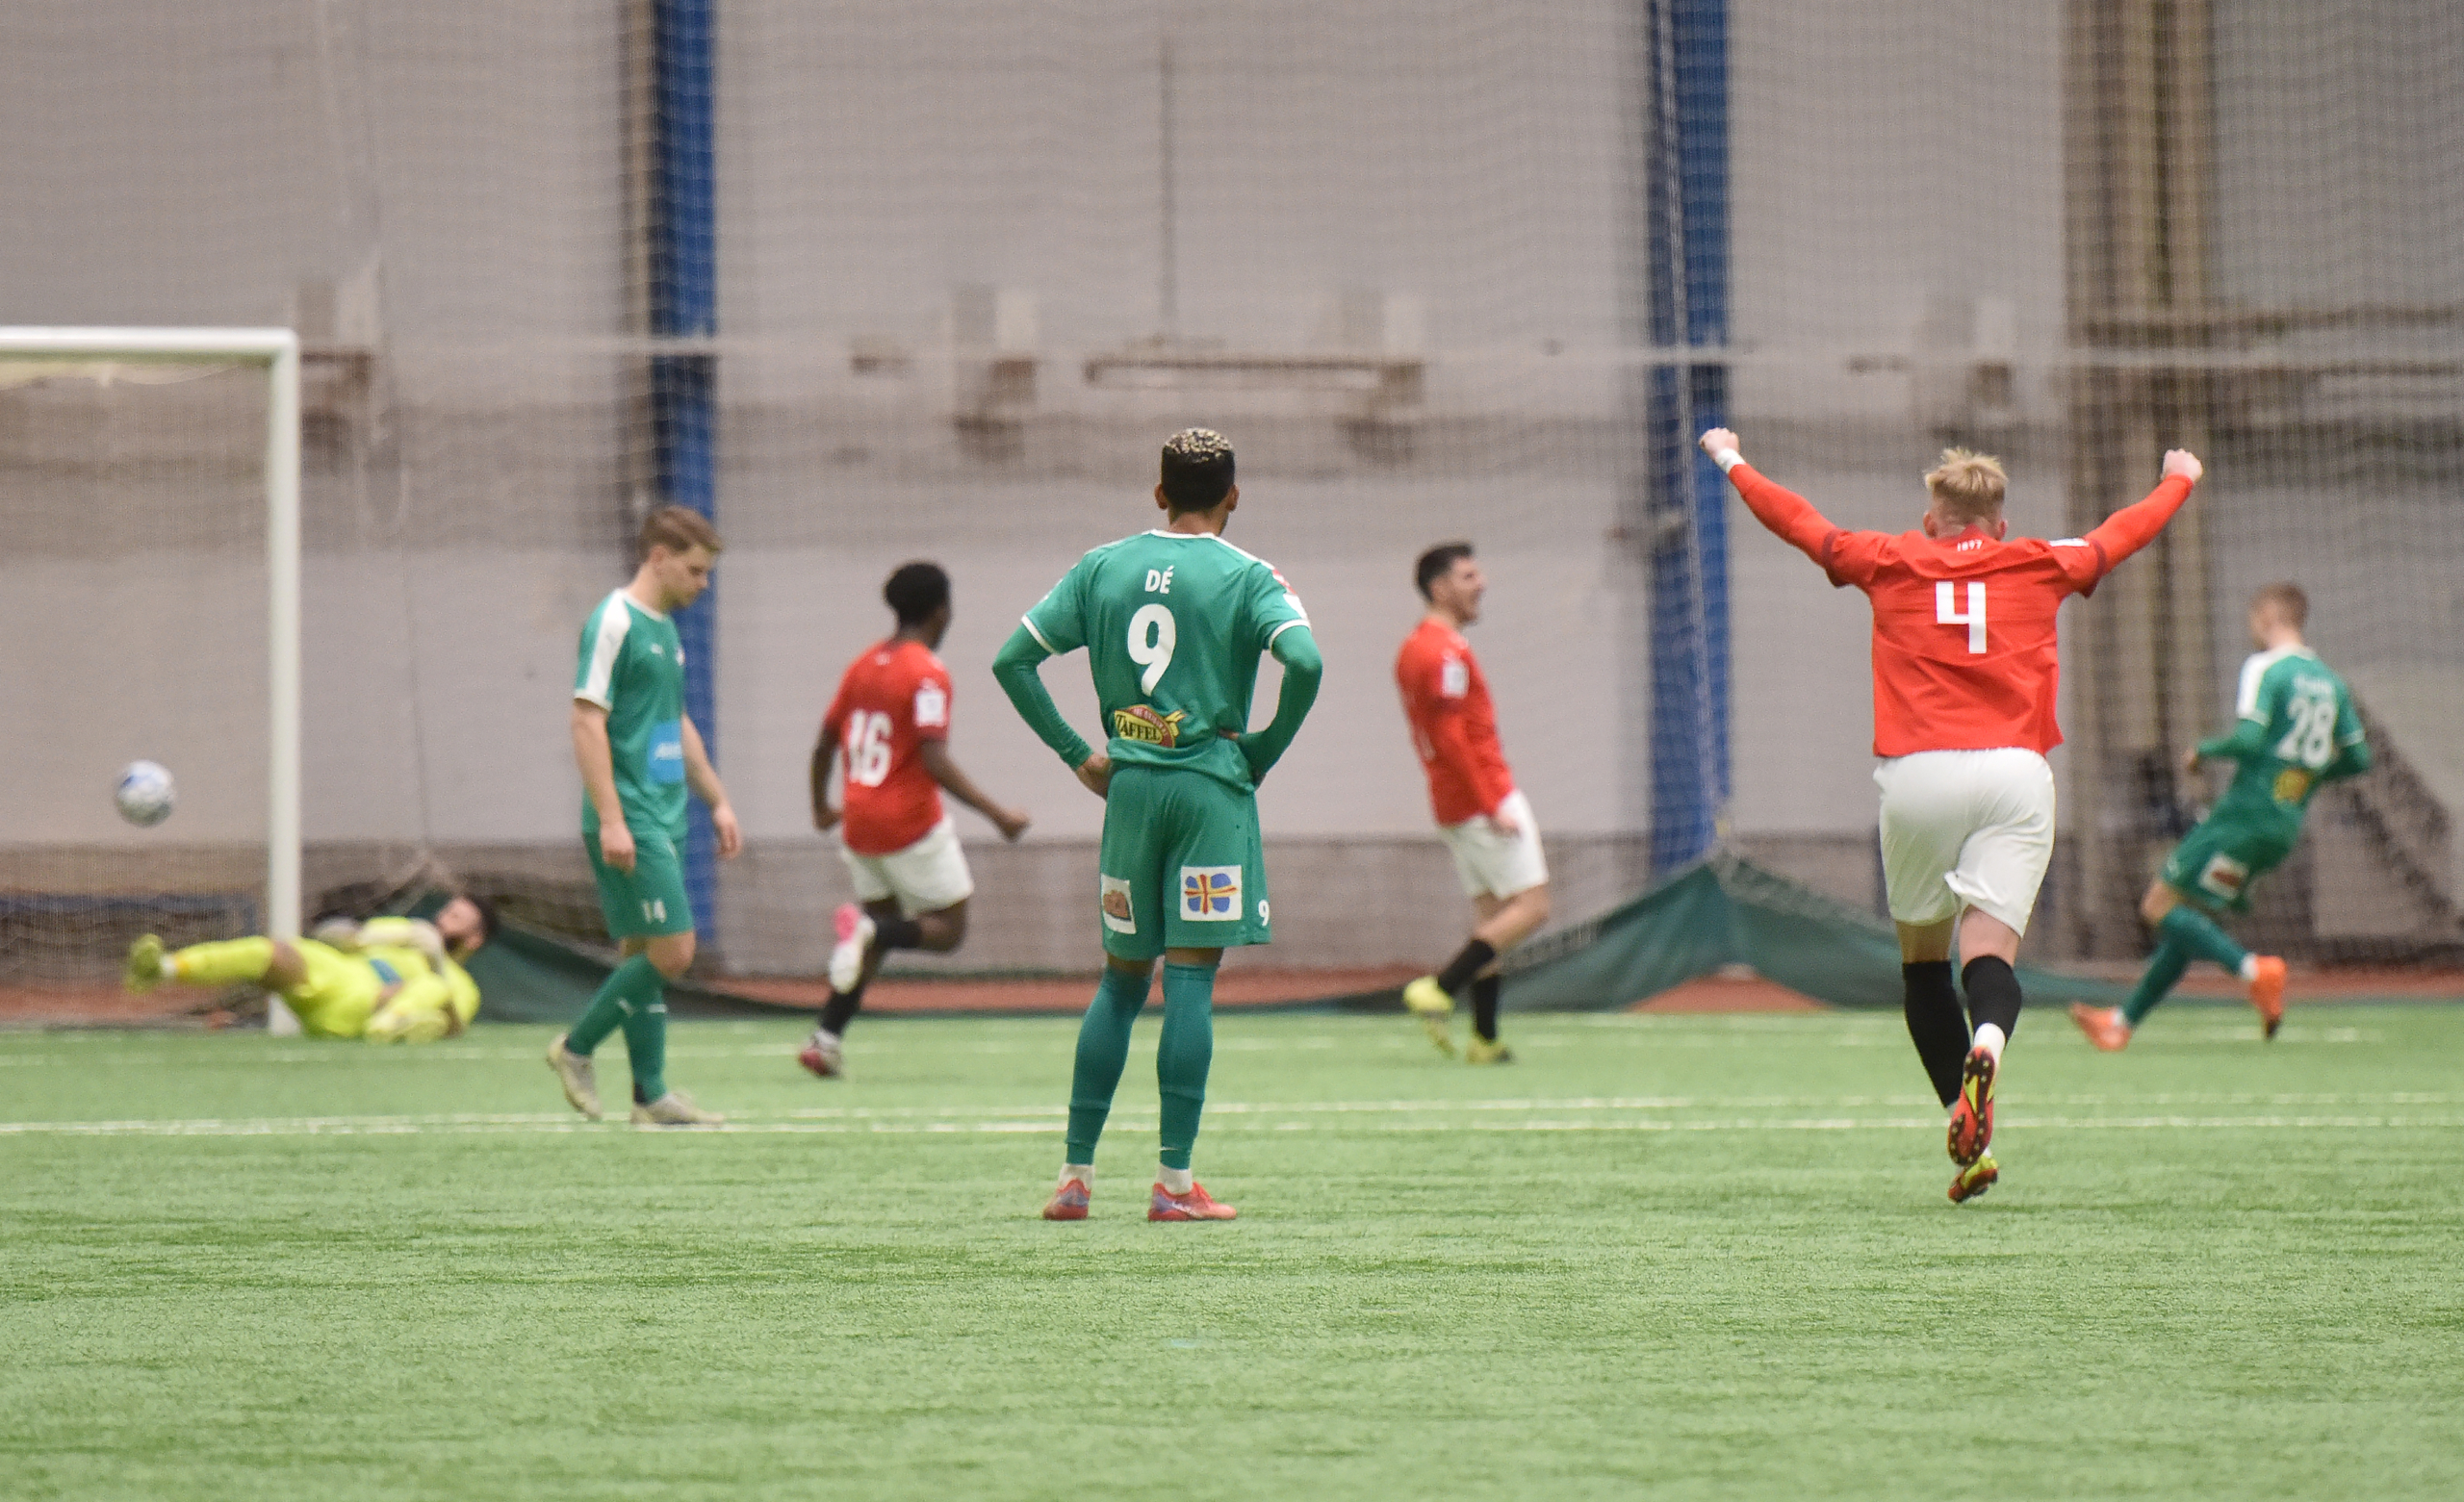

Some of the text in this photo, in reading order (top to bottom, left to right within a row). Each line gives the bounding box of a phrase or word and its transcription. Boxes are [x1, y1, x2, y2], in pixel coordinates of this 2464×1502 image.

[1144, 565, 1174, 594] DÉ
[1127, 603, 1176, 697] 9
[1936, 580, 1988, 654] 4
[849, 708, 893, 787] 16
[2276, 697, 2337, 768] 28
[1258, 900, 1270, 927] 9
